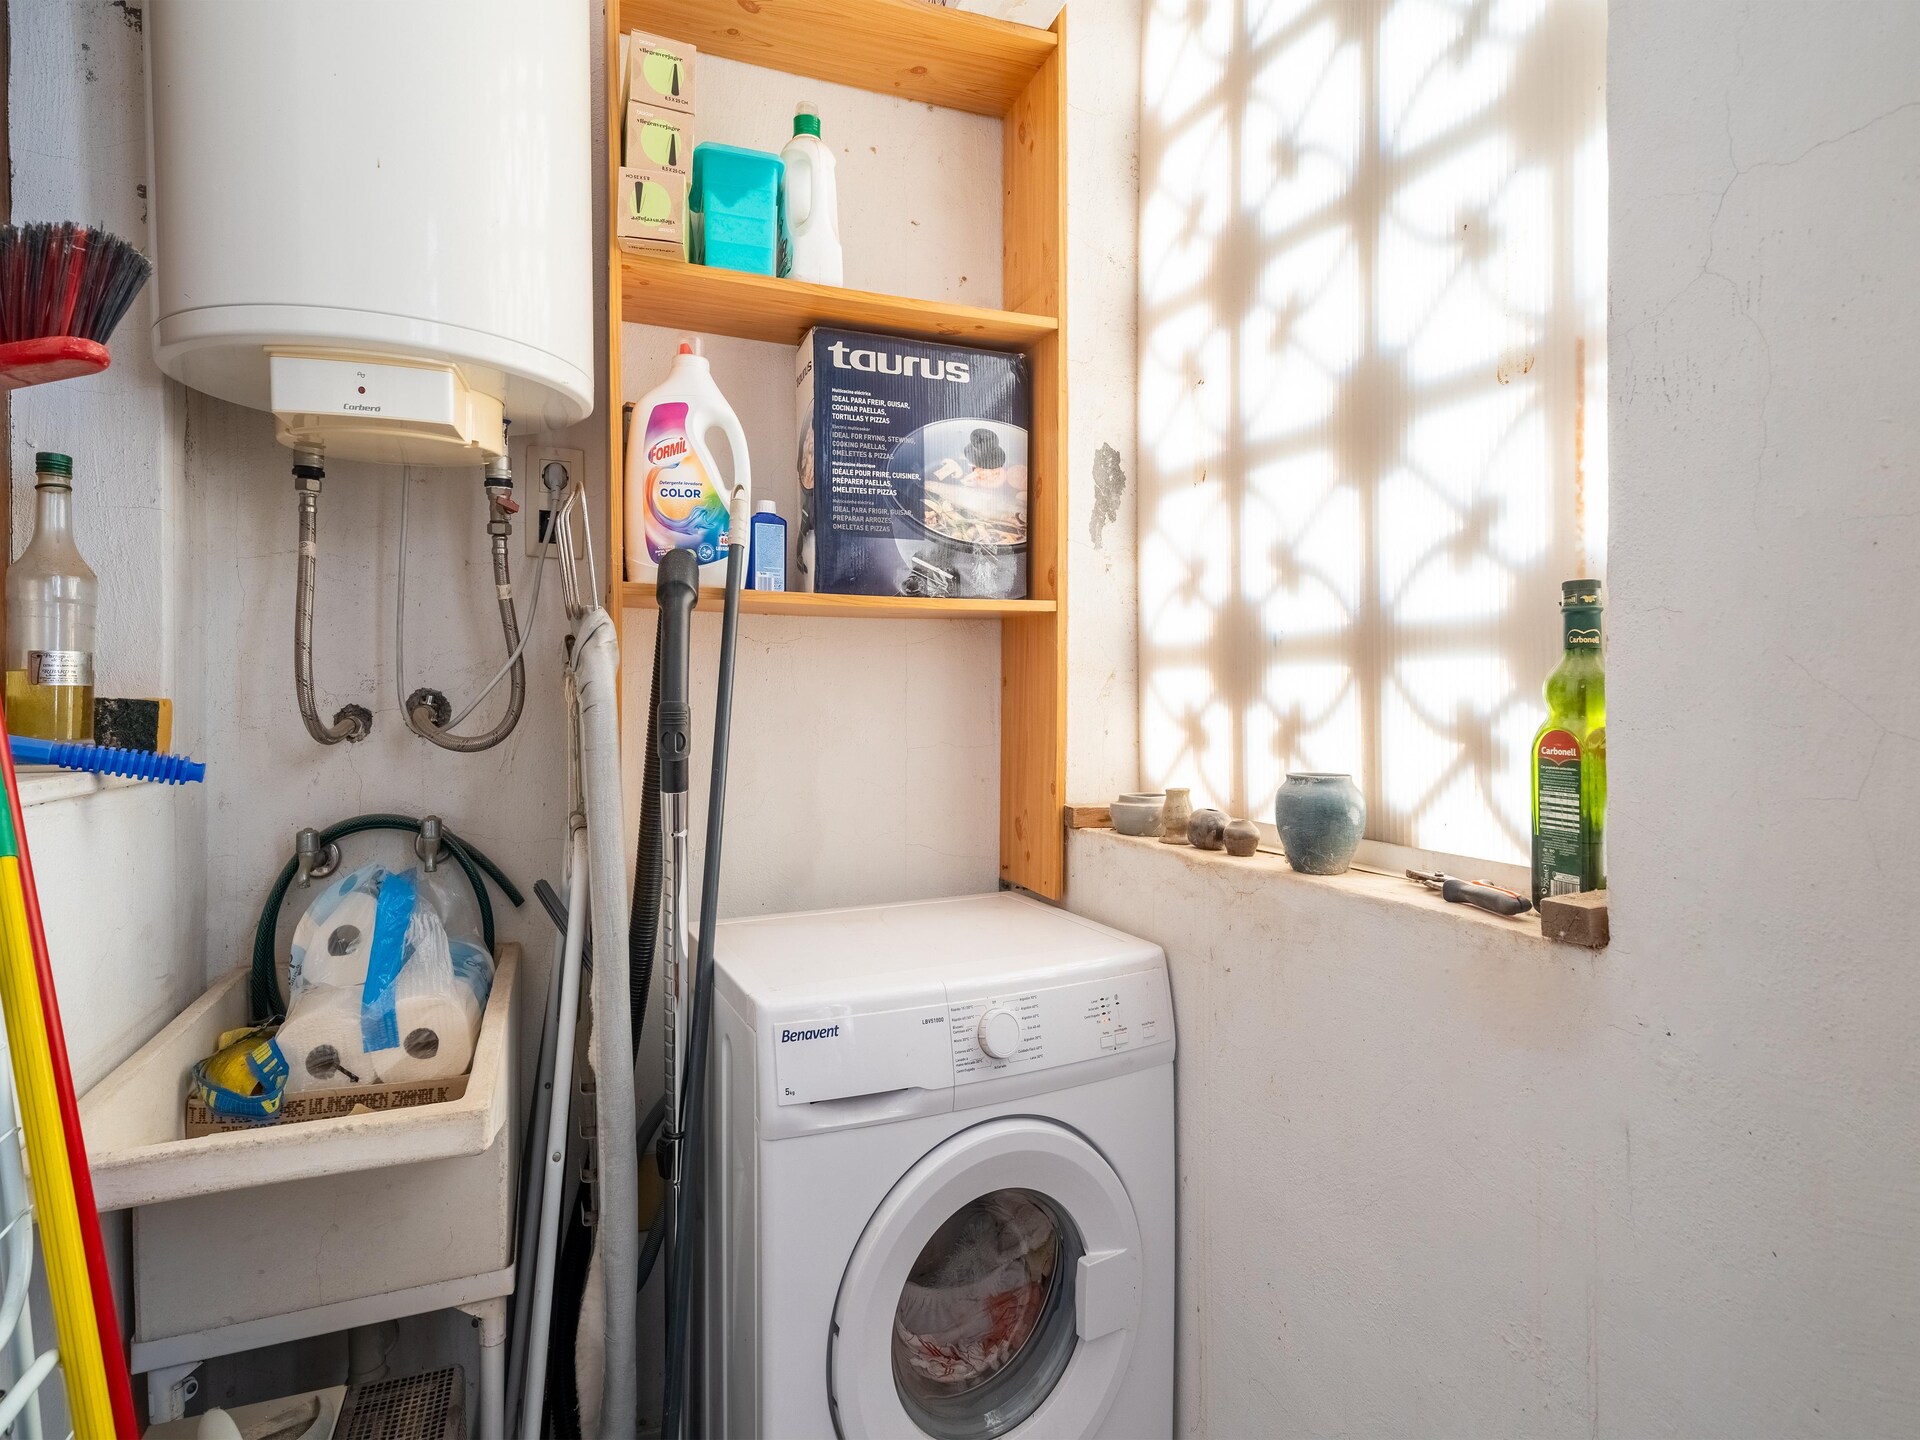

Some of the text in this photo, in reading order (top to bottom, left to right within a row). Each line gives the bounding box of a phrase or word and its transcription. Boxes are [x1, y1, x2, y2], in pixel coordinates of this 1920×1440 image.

[827, 341, 970, 383] taurus
[832, 395, 850, 403] IDEAL
[850, 397, 866, 405] PARA
[887, 400, 910, 410] GUISAR,
[832, 404, 887, 416] COCINAR PAELLAS,
[832, 413, 864, 422] TORTILLAS
[864, 434, 887, 442] FRYING,
[887, 436, 916, 444] STEWING,
[832, 440, 887, 451] COOKING PAELLAS,
[832, 450, 867, 458] OMELETTES
[874, 452, 894, 460] PIZZAS
[832, 467, 854, 475] IDÉALE
[892, 472, 921, 481] CUISINER,
[832, 476, 864, 484] PRÉPARER
[660, 488, 701, 498] COLOR
[832, 486, 867, 494] OMELETTES
[890, 509, 914, 517] GUISAR,
[1569, 636, 1600, 644] Carbonell
[1541, 746, 1576, 756] Carbonell
[782, 1024, 839, 1043] Benavent
